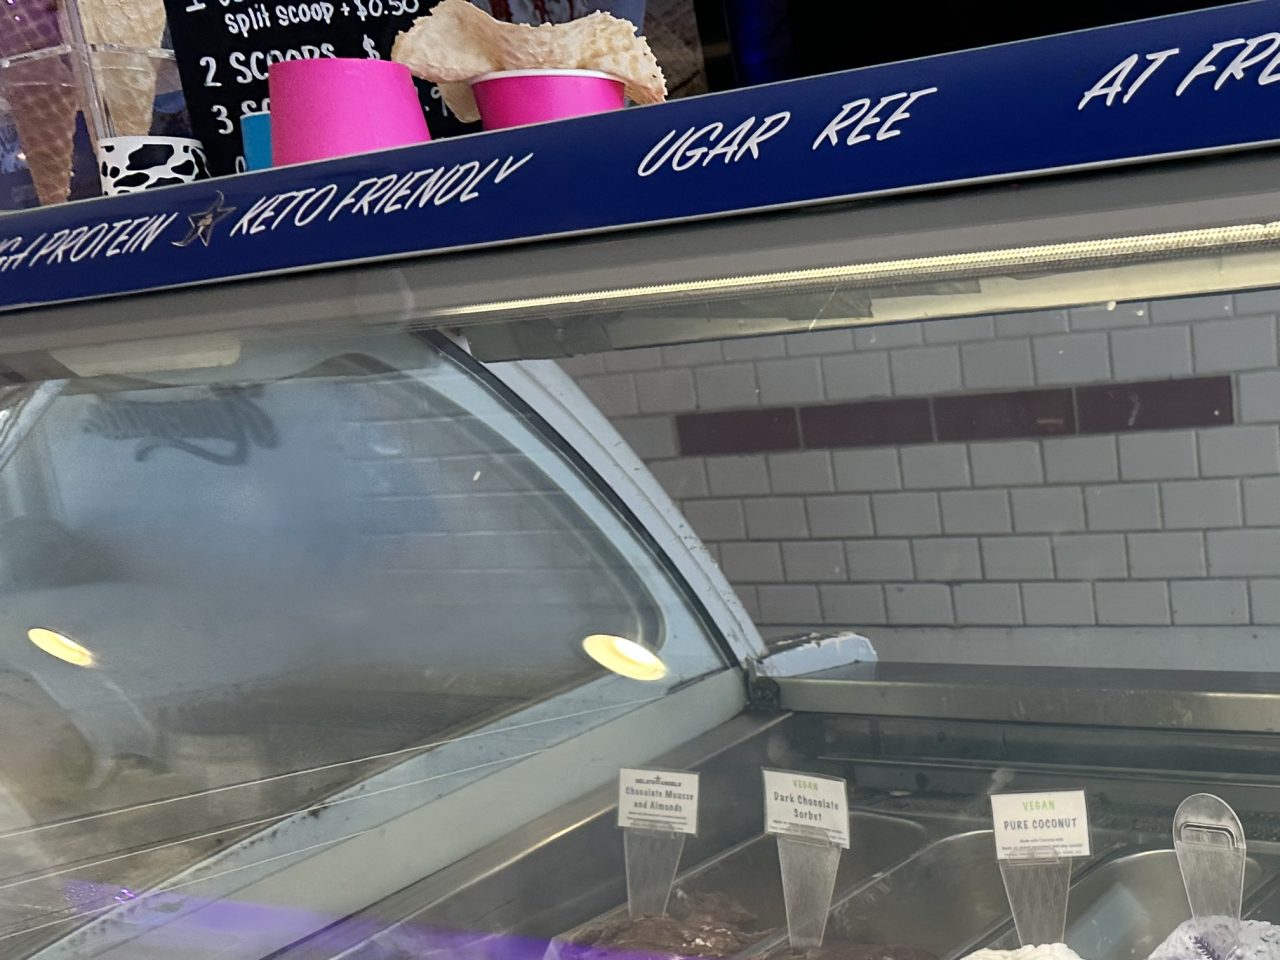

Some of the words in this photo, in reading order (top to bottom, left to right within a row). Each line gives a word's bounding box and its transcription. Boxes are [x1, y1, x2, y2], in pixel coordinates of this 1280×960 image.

[225, 3, 270, 38] split
[275, 1, 334, 26] scoop
[200, 56, 222, 87] 2
[211, 105, 234, 135] 3
[230, 184, 338, 237] KETO
[29, 212, 179, 267] PROTEIN
[625, 786, 662, 798] Chocolate
[665, 789, 694, 800] Mousse
[792, 779, 818, 791] VEGAN
[634, 801, 647, 809] and
[650, 801, 682, 812] Almonds
[774, 791, 795, 804] Dark
[797, 795, 839, 810] Chocolate
[1022, 800, 1055, 812] VEGAN
[793, 808, 822, 821] Sorbet
[1004, 818, 1028, 830] PURE
[1032, 817, 1077, 829] COCONUT
